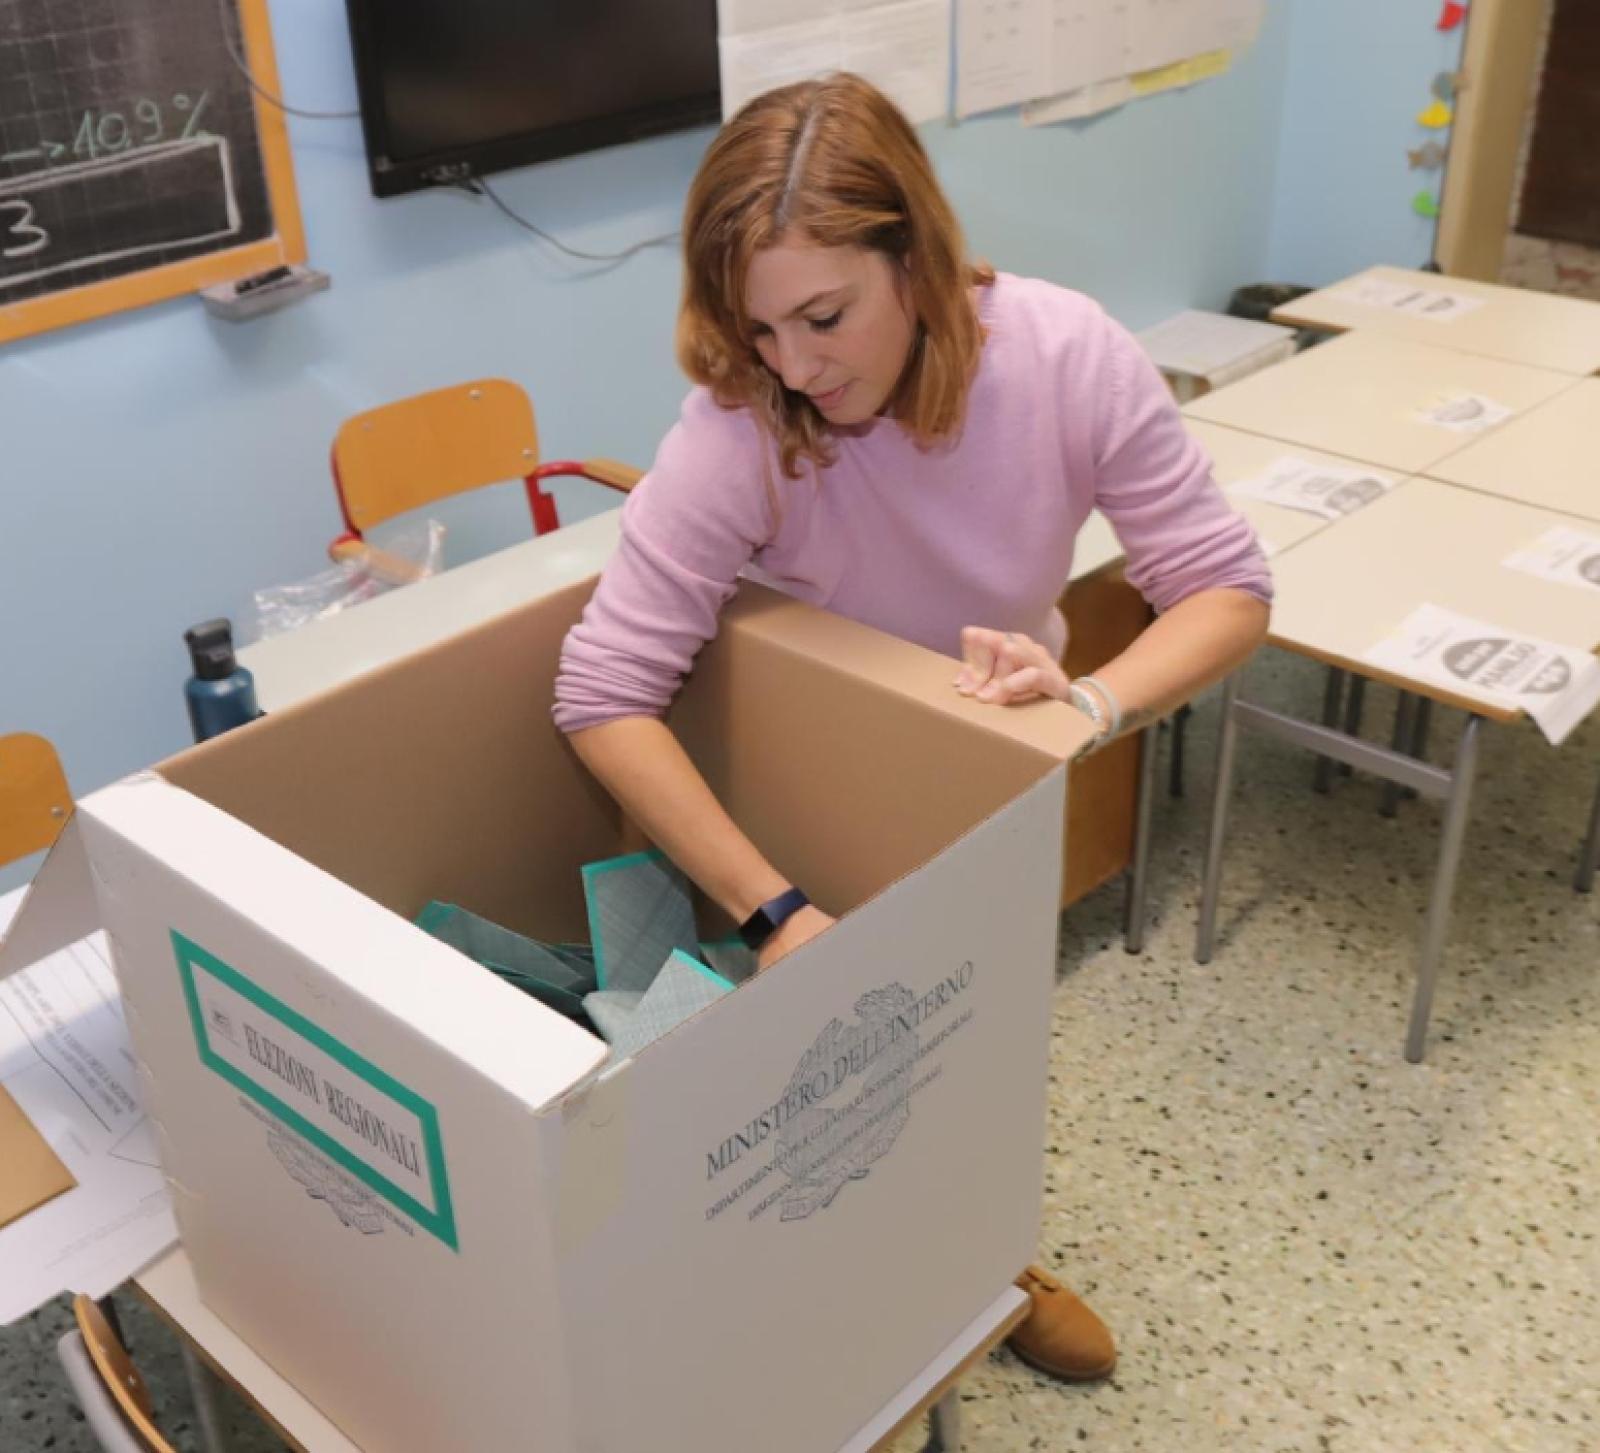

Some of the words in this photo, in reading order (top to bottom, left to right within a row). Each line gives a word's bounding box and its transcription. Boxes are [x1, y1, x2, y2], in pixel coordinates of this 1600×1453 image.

[244, 1023, 321, 1104] ELEZIONI
[323, 1079, 422, 1177] REGIONALI
[705, 1071, 828, 1181] MINISTERO
